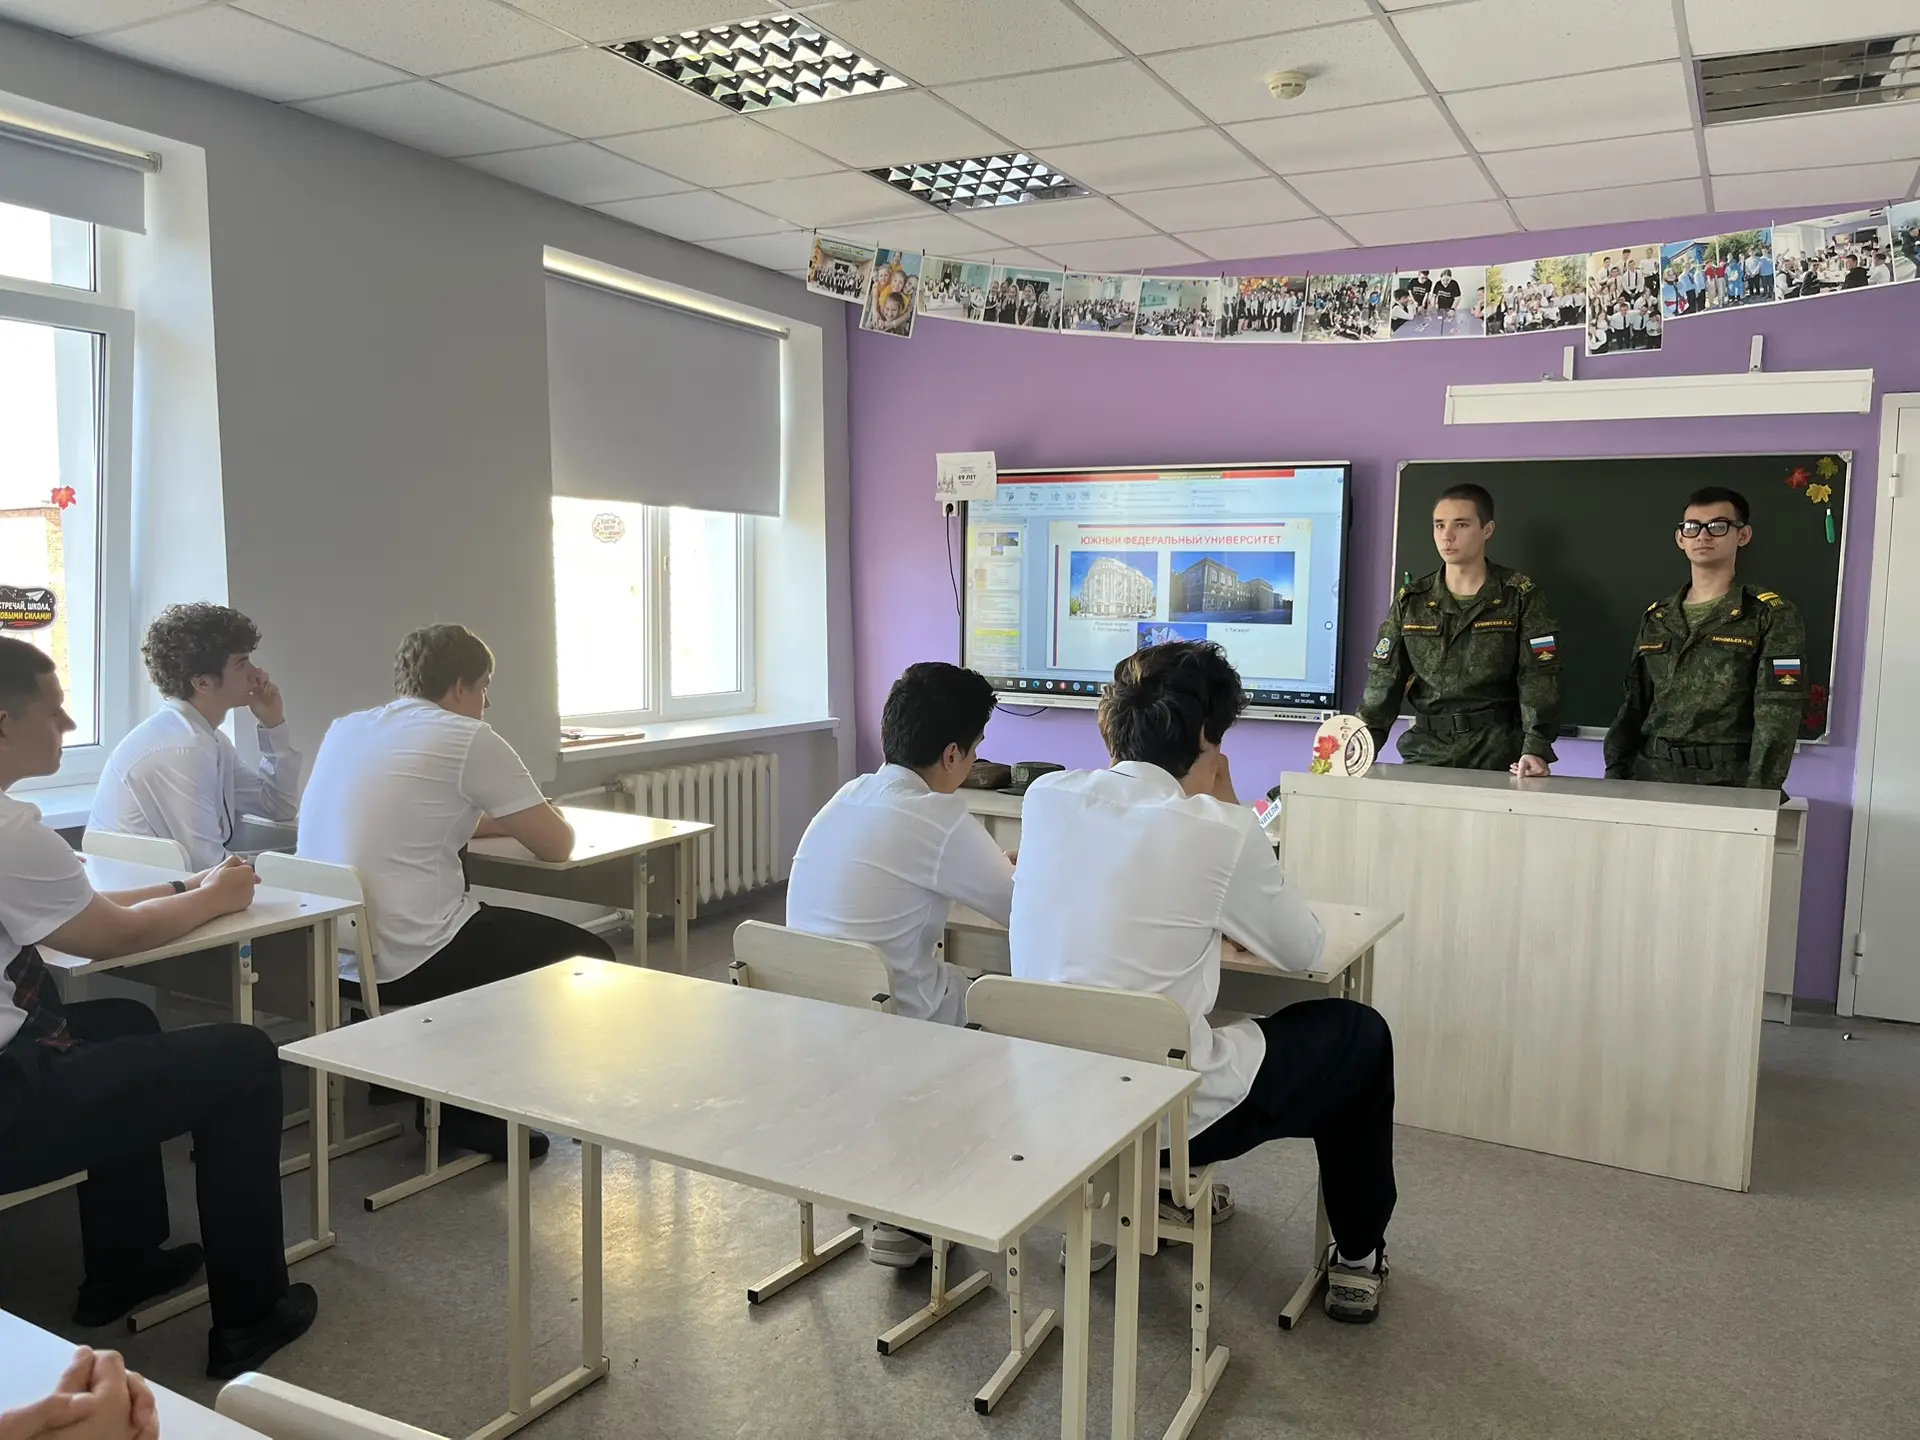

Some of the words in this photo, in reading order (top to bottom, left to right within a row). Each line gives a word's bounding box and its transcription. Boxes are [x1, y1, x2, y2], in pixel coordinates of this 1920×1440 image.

[1080, 535, 1121, 545] ЮЖНЫЙ
[1124, 534, 1202, 546] ФЕДЕРАЛЬНЫЙ
[1204, 534, 1281, 545] УНИВЕРСИТЕТ
[0, 601, 26, 611] ТРЕЧАЙ,
[27, 602, 51, 611] ШКОЛА,
[24, 612, 52, 620] СИЛАМИ!
